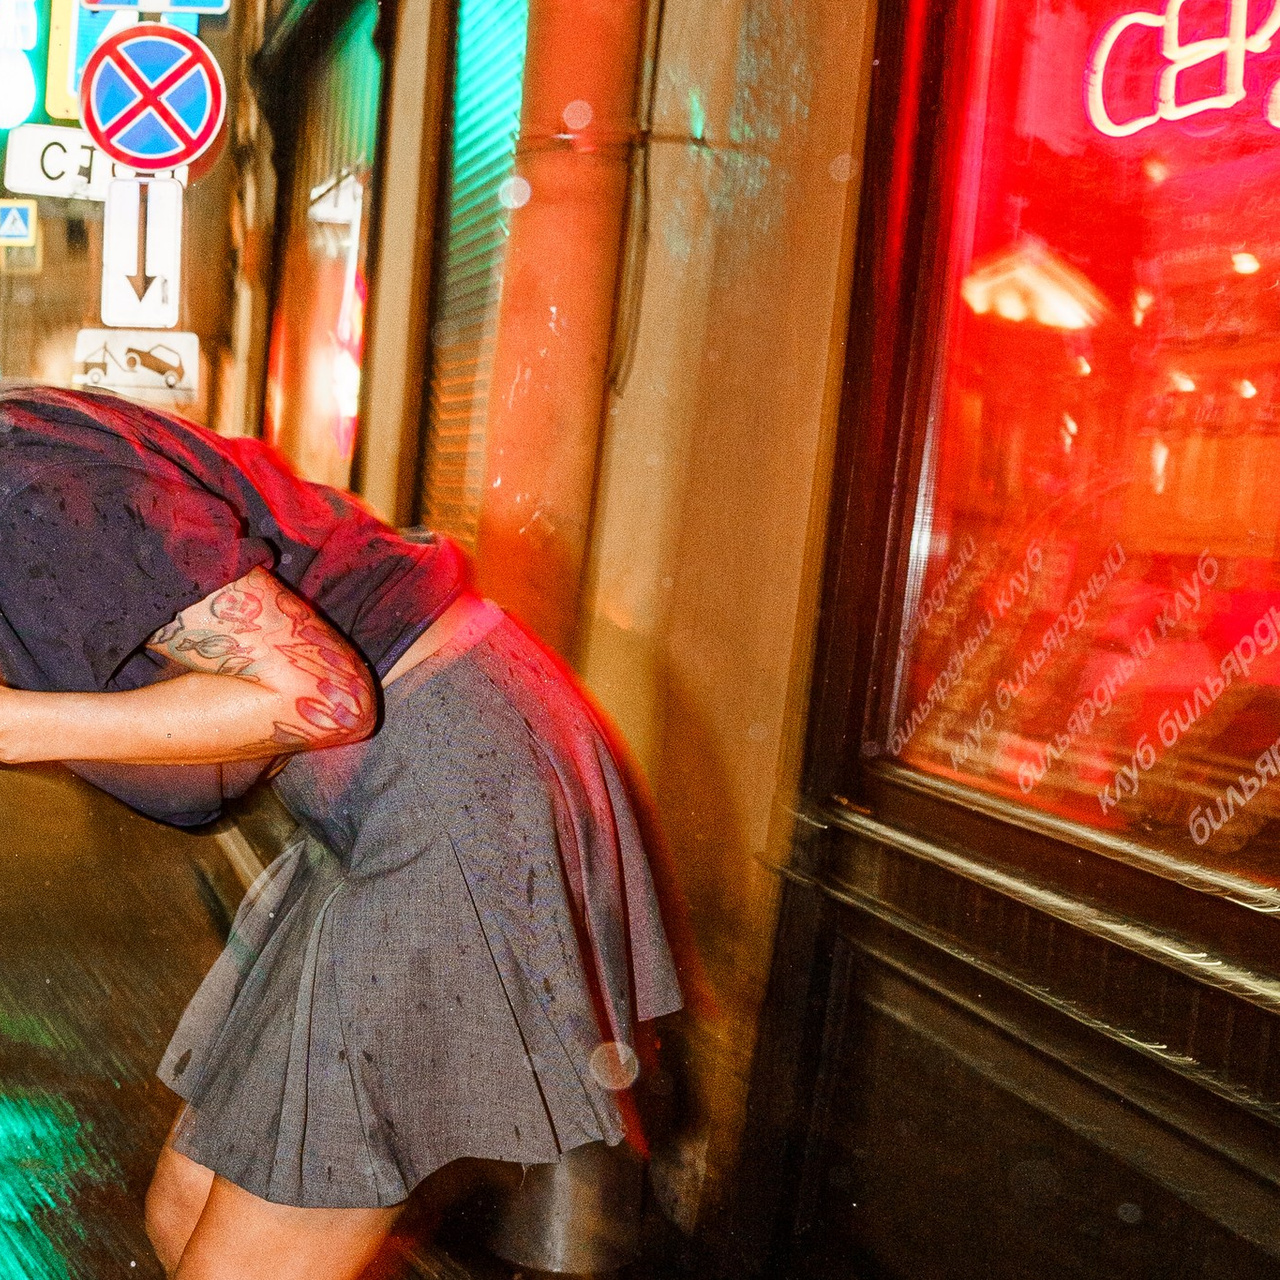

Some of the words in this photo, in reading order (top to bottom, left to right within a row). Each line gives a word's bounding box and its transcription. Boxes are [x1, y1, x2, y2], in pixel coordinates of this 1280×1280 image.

[995, 540, 1043, 617] клуб
[1156, 548, 1219, 638] клуб
[950, 700, 994, 771] клуб
[1097, 733, 1157, 815] клуб
